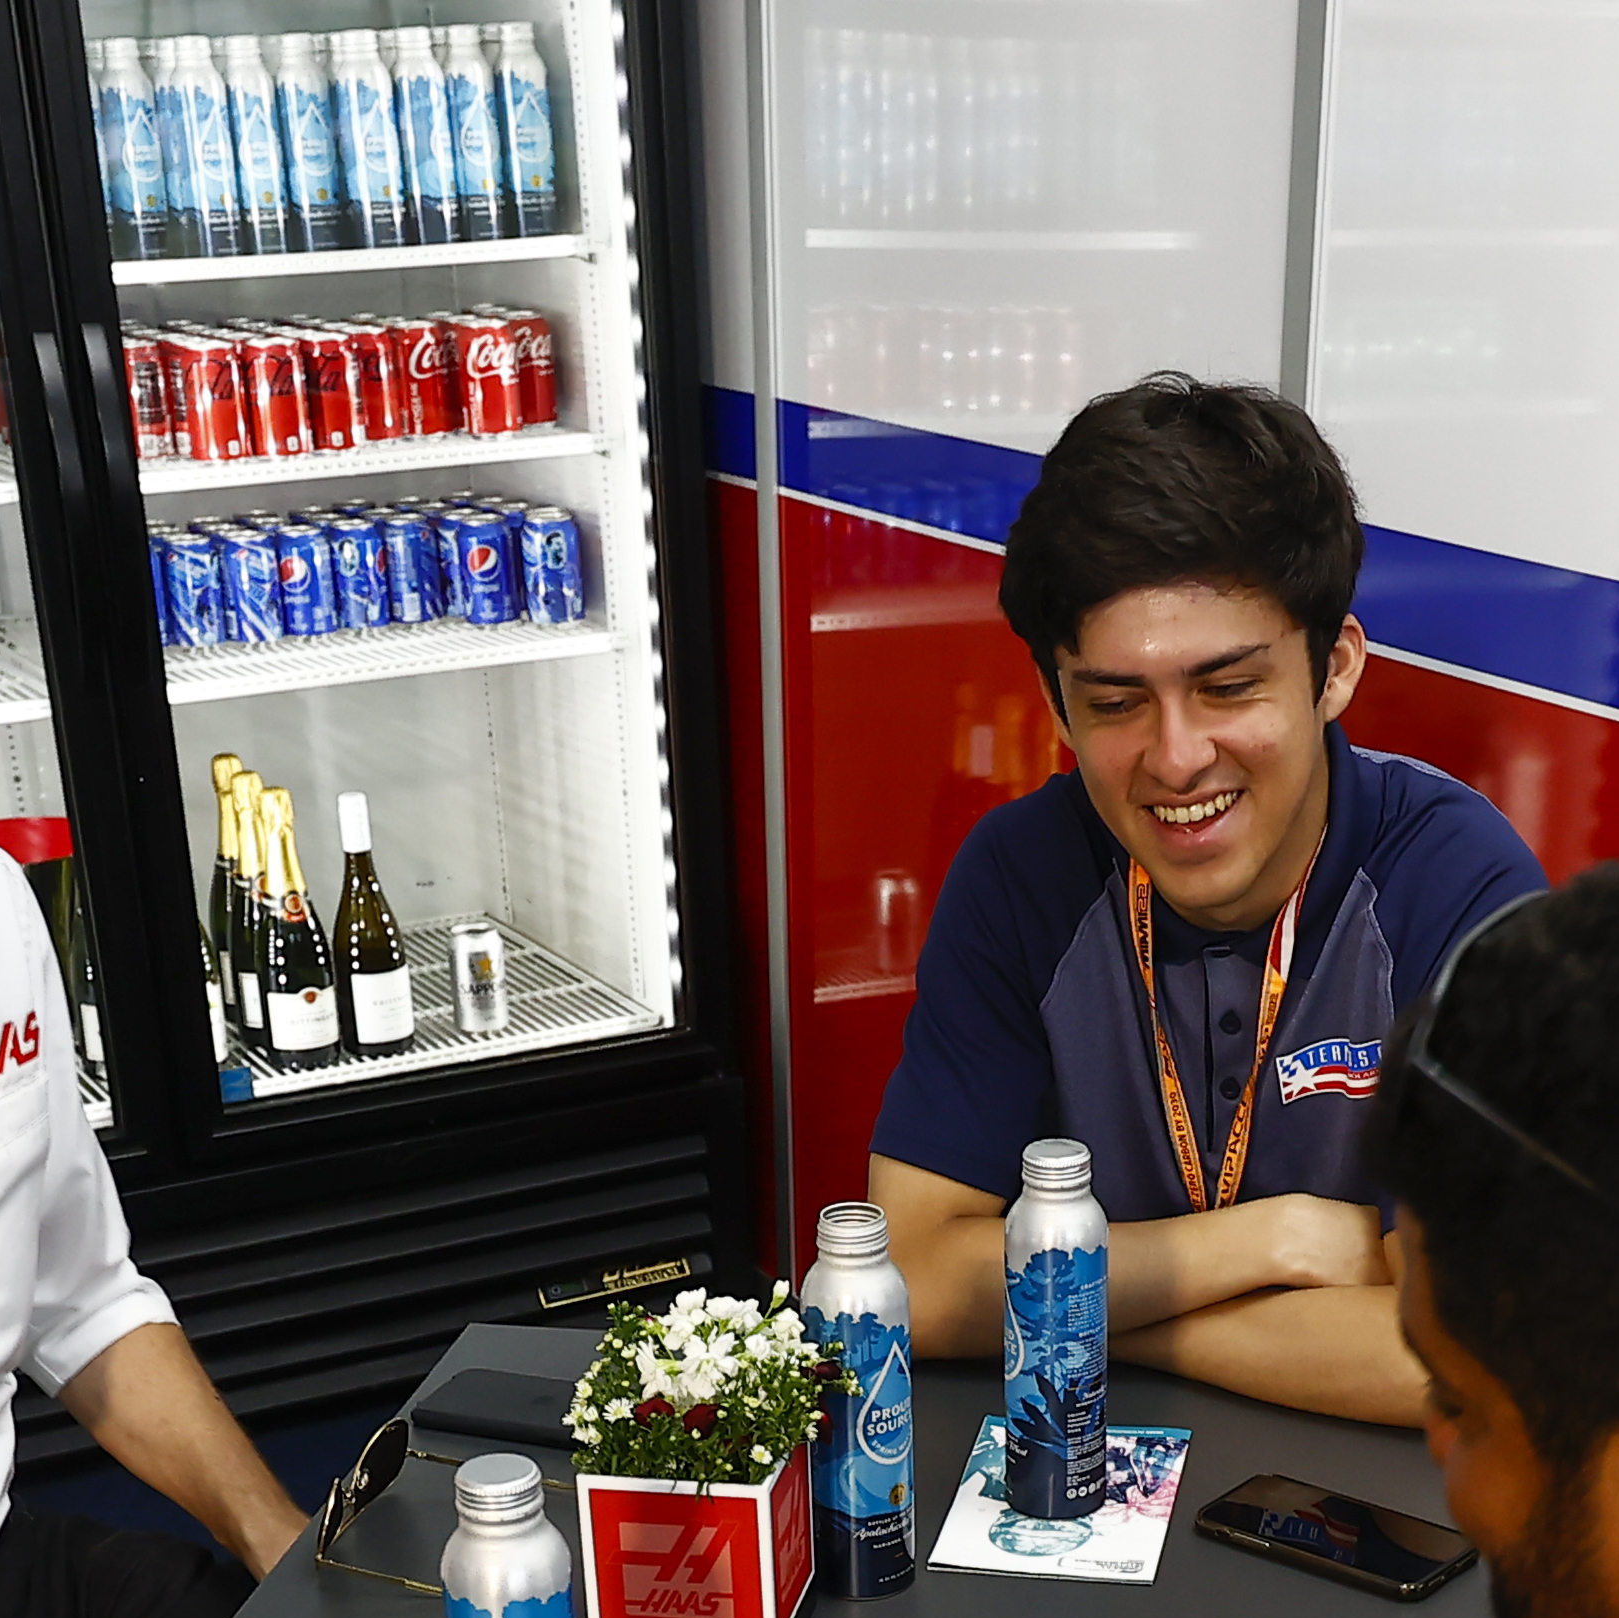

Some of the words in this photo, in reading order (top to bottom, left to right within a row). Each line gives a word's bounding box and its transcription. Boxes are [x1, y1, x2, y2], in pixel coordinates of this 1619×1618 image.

[1175, 1118, 1185, 1133] BY
[1180, 1134, 1195, 1173] CARBON
[1221, 1158, 1235, 1195] VIP
[626, 1588, 733, 1617] HAAS
